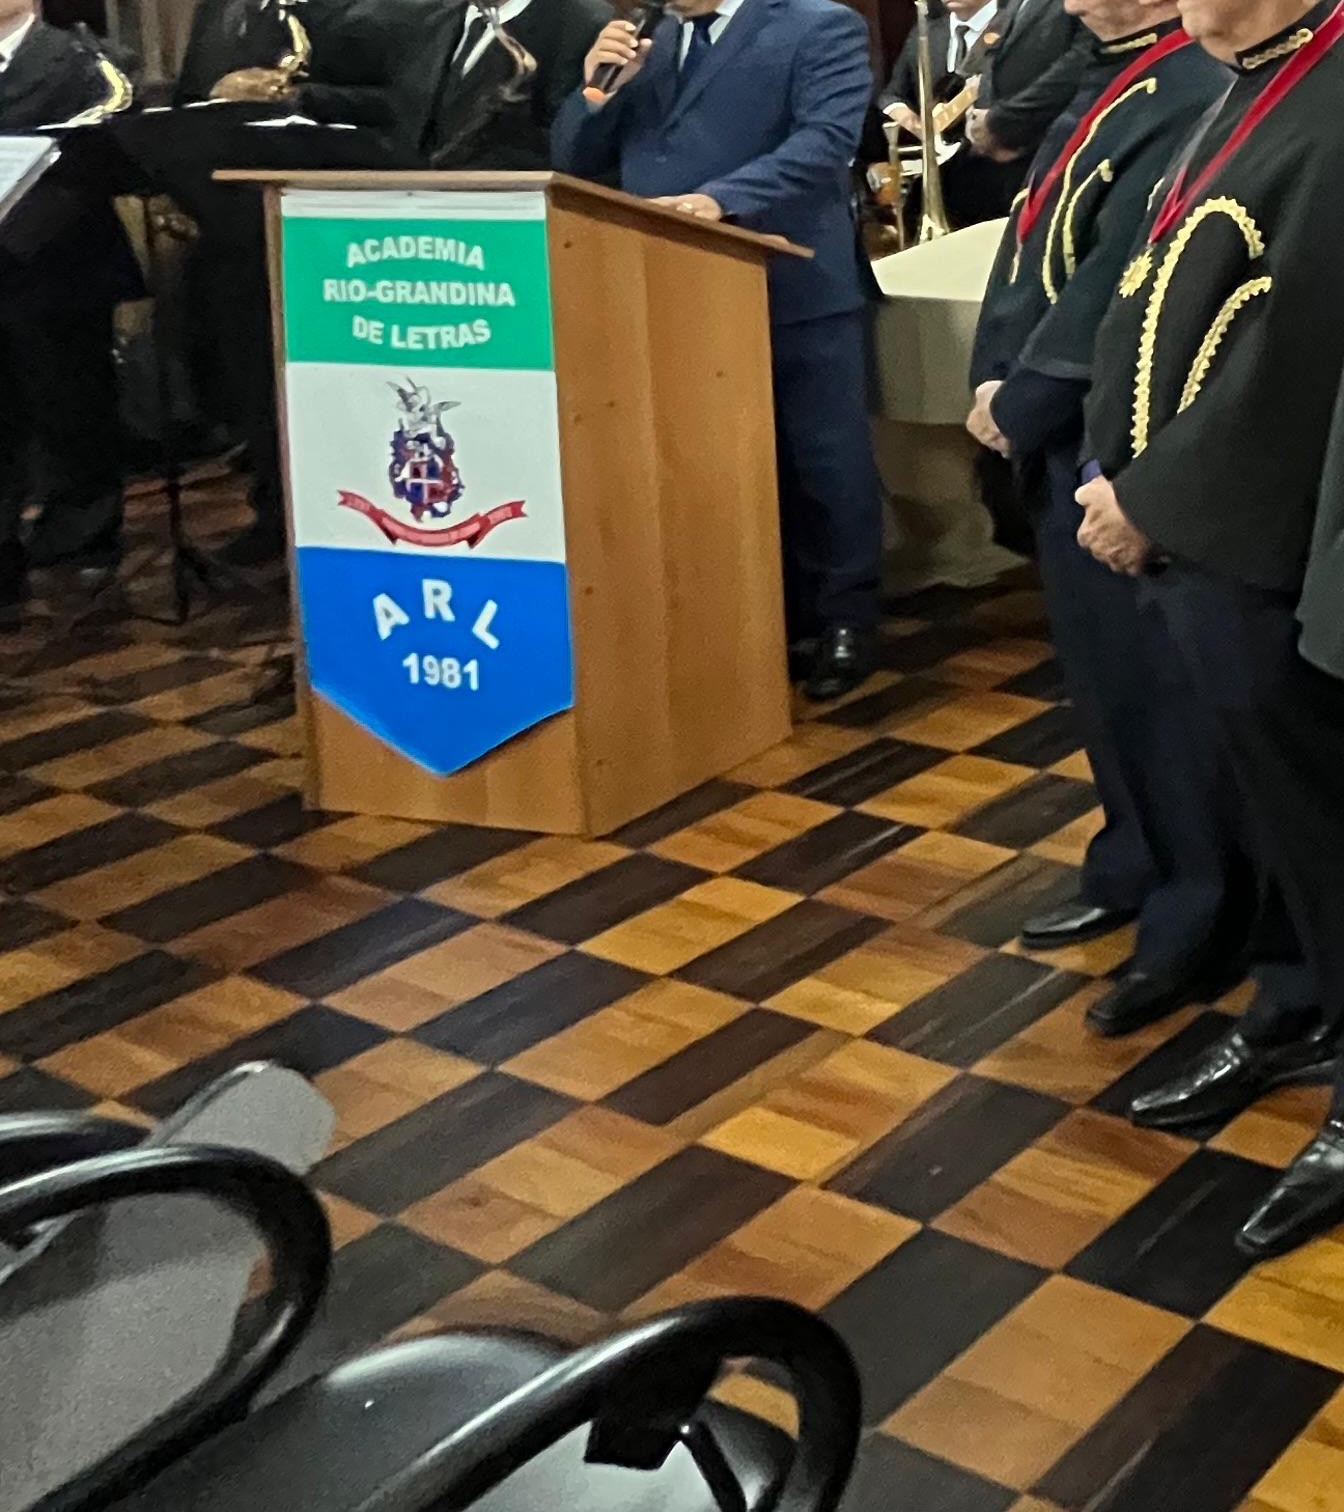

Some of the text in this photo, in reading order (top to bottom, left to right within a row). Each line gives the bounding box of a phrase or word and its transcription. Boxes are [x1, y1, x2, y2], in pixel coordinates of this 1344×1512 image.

[346, 235, 486, 270] ACADEMIA
[322, 277, 516, 307] RIO-GRANDINA
[352, 314, 493, 350] DE LETRAS
[402, 652, 480, 692] 1981
